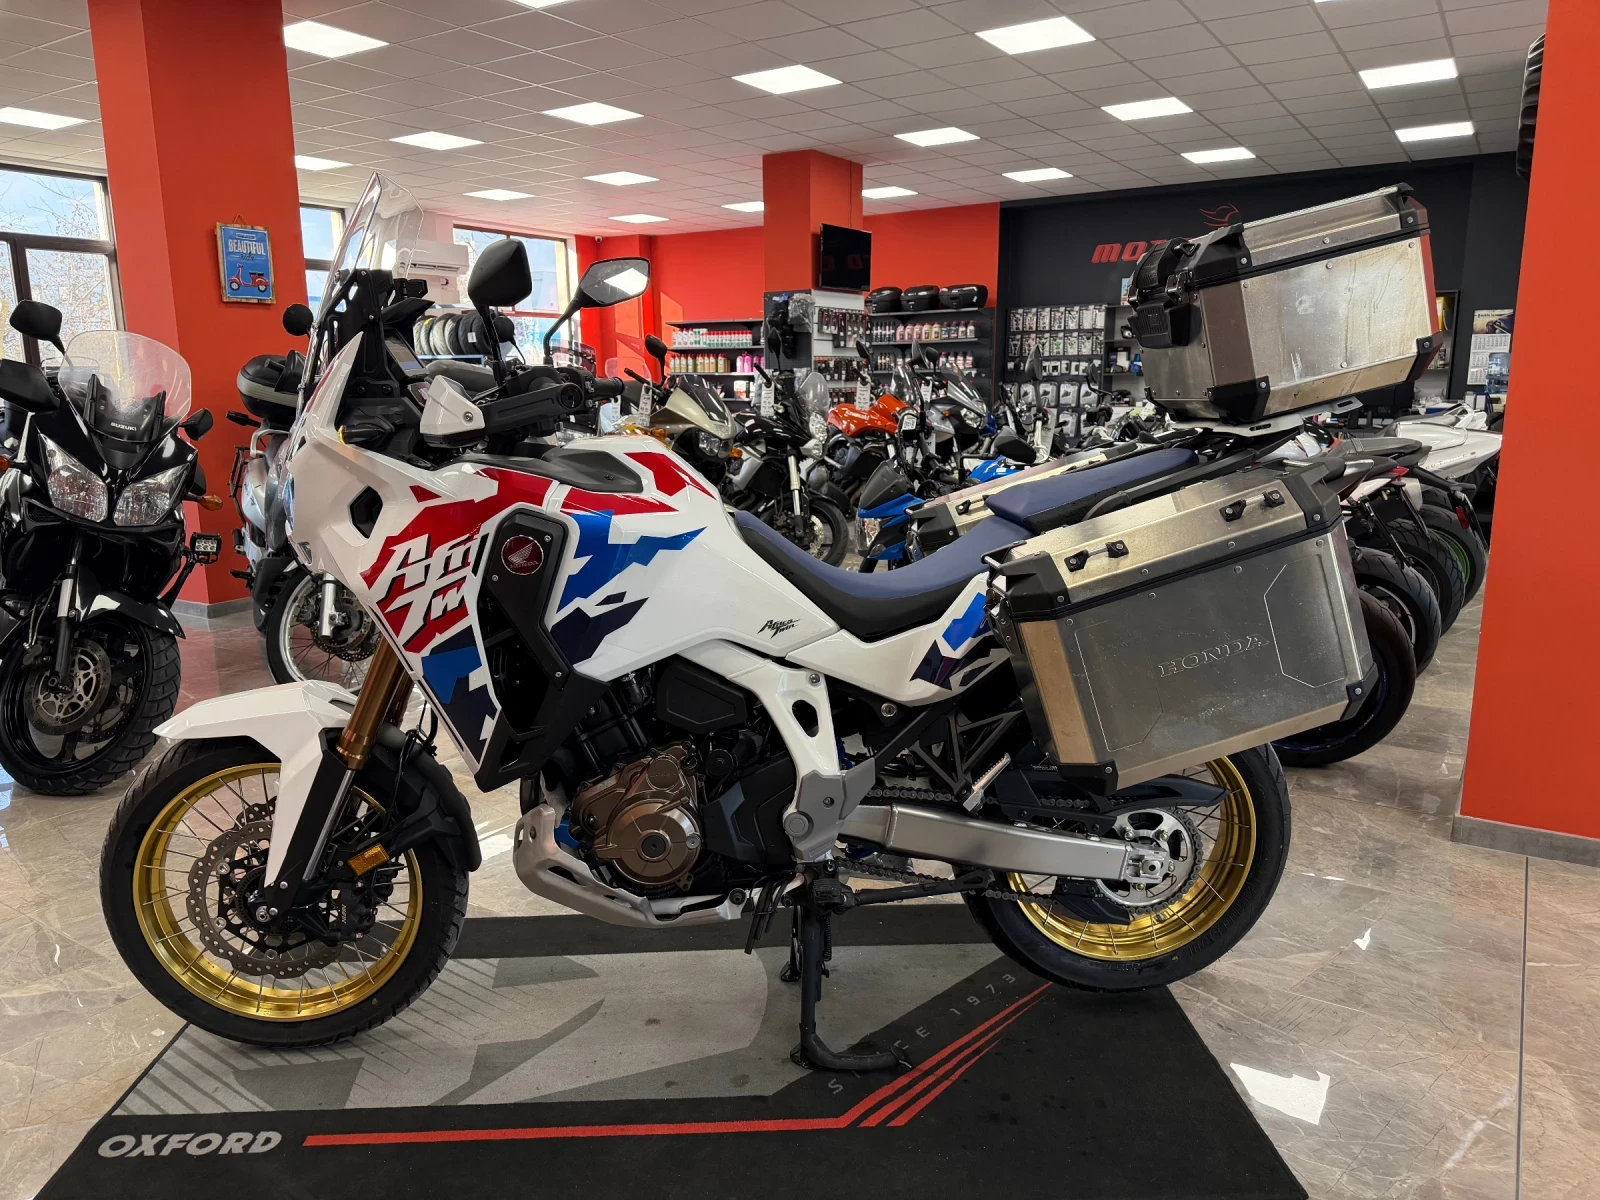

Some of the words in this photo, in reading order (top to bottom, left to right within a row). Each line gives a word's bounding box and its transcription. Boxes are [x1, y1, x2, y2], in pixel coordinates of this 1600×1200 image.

[228, 239, 266, 255] BEAUTIFUL
[110, 421, 137, 431] SUZUKI
[1158, 634, 1270, 677] HONDA
[950, 973, 1016, 1016] 1973
[98, 1131, 282, 1158] OXFORD
